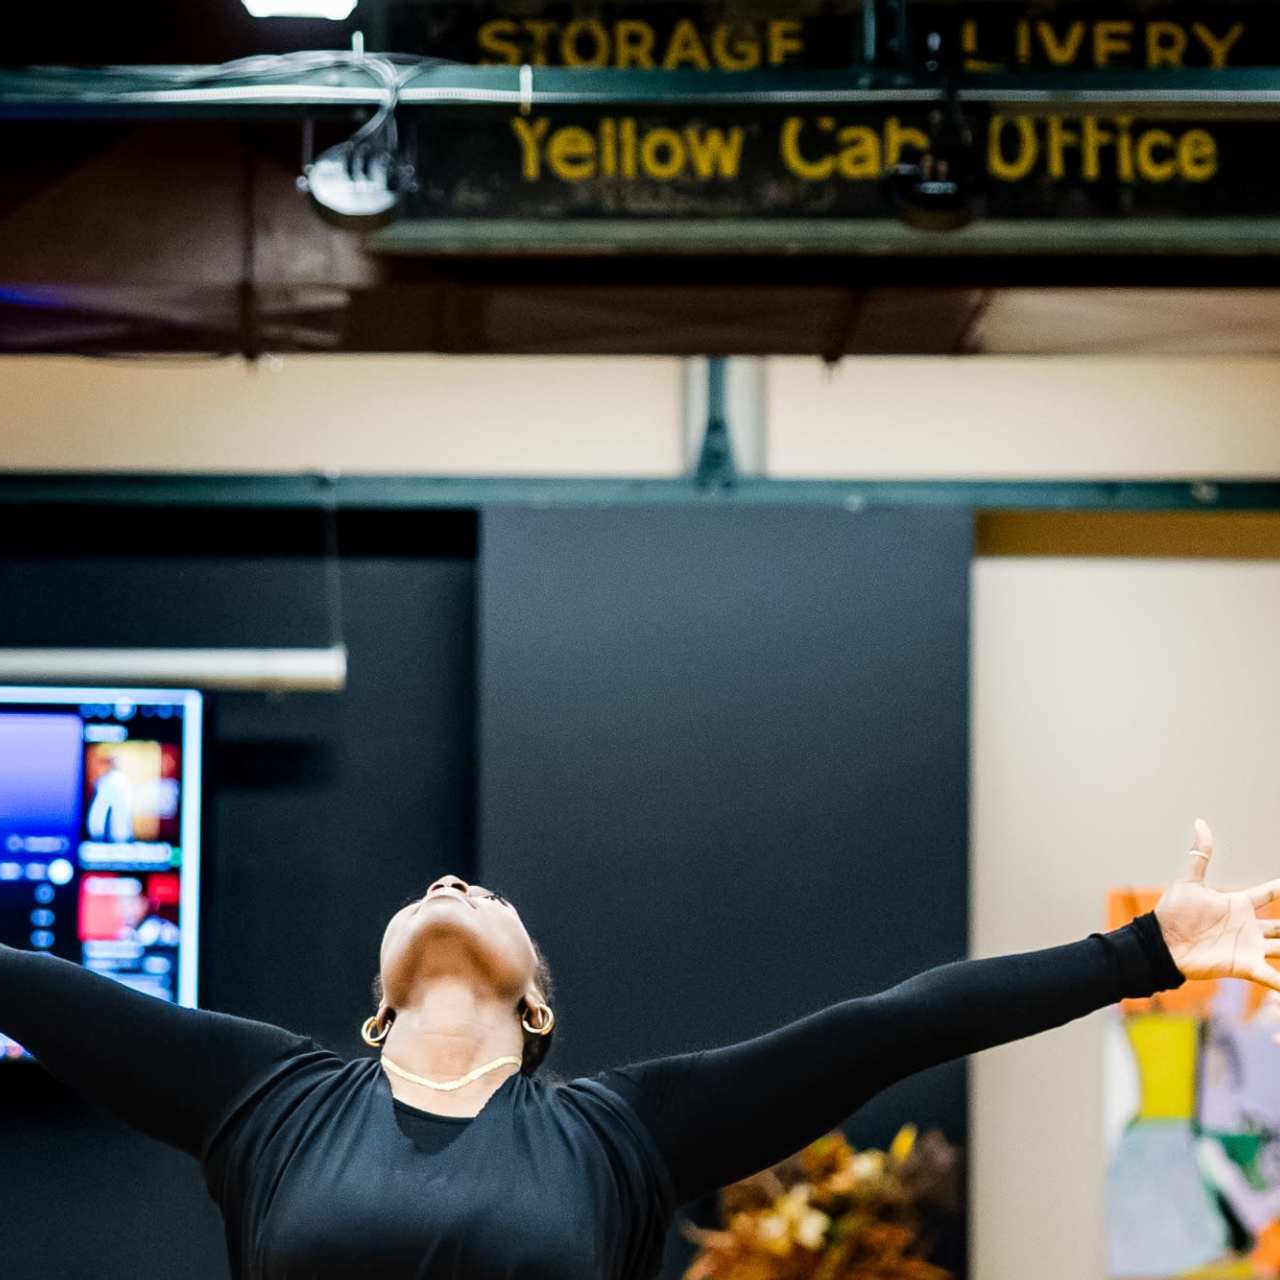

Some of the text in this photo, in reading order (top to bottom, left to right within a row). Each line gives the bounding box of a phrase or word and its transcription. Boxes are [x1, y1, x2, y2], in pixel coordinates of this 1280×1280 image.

[478, 19, 803, 71] STORAGE
[512, 117, 744, 181] Yellow
[987, 115, 1218, 181] Office
